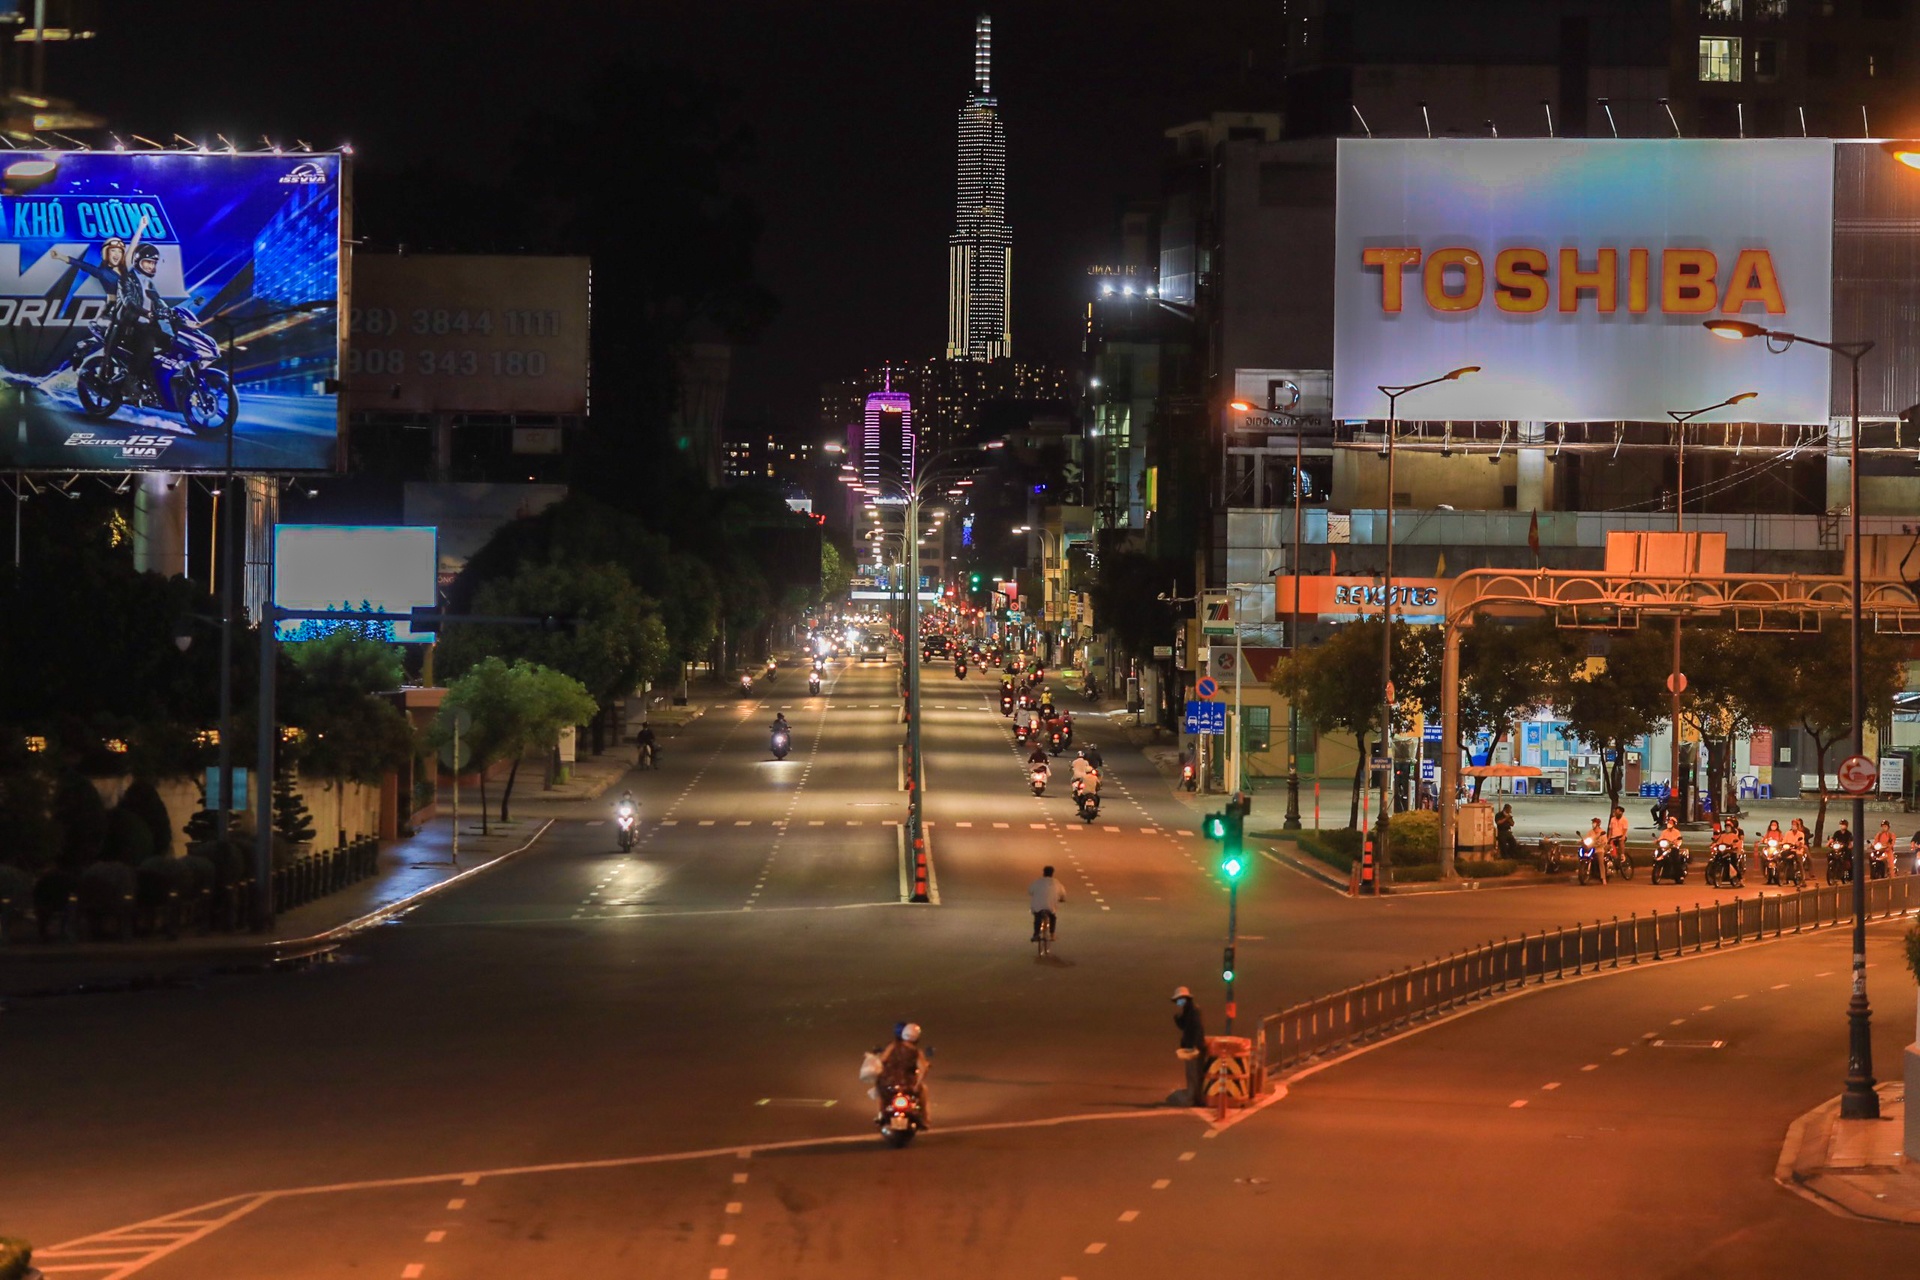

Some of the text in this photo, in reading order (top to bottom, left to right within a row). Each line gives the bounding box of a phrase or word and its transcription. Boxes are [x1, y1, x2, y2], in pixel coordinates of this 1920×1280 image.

[13, 197, 65, 239] KHÓ
[77, 198, 167, 239] CƯỠNG
[1363, 247, 1787, 315] TOSHIBA
[411, 307, 493, 336] 3844
[504, 309, 560, 337] 1111
[418, 349, 478, 376] 343
[490, 350, 546, 377] 180
[122, 447, 158, 456] VVA
